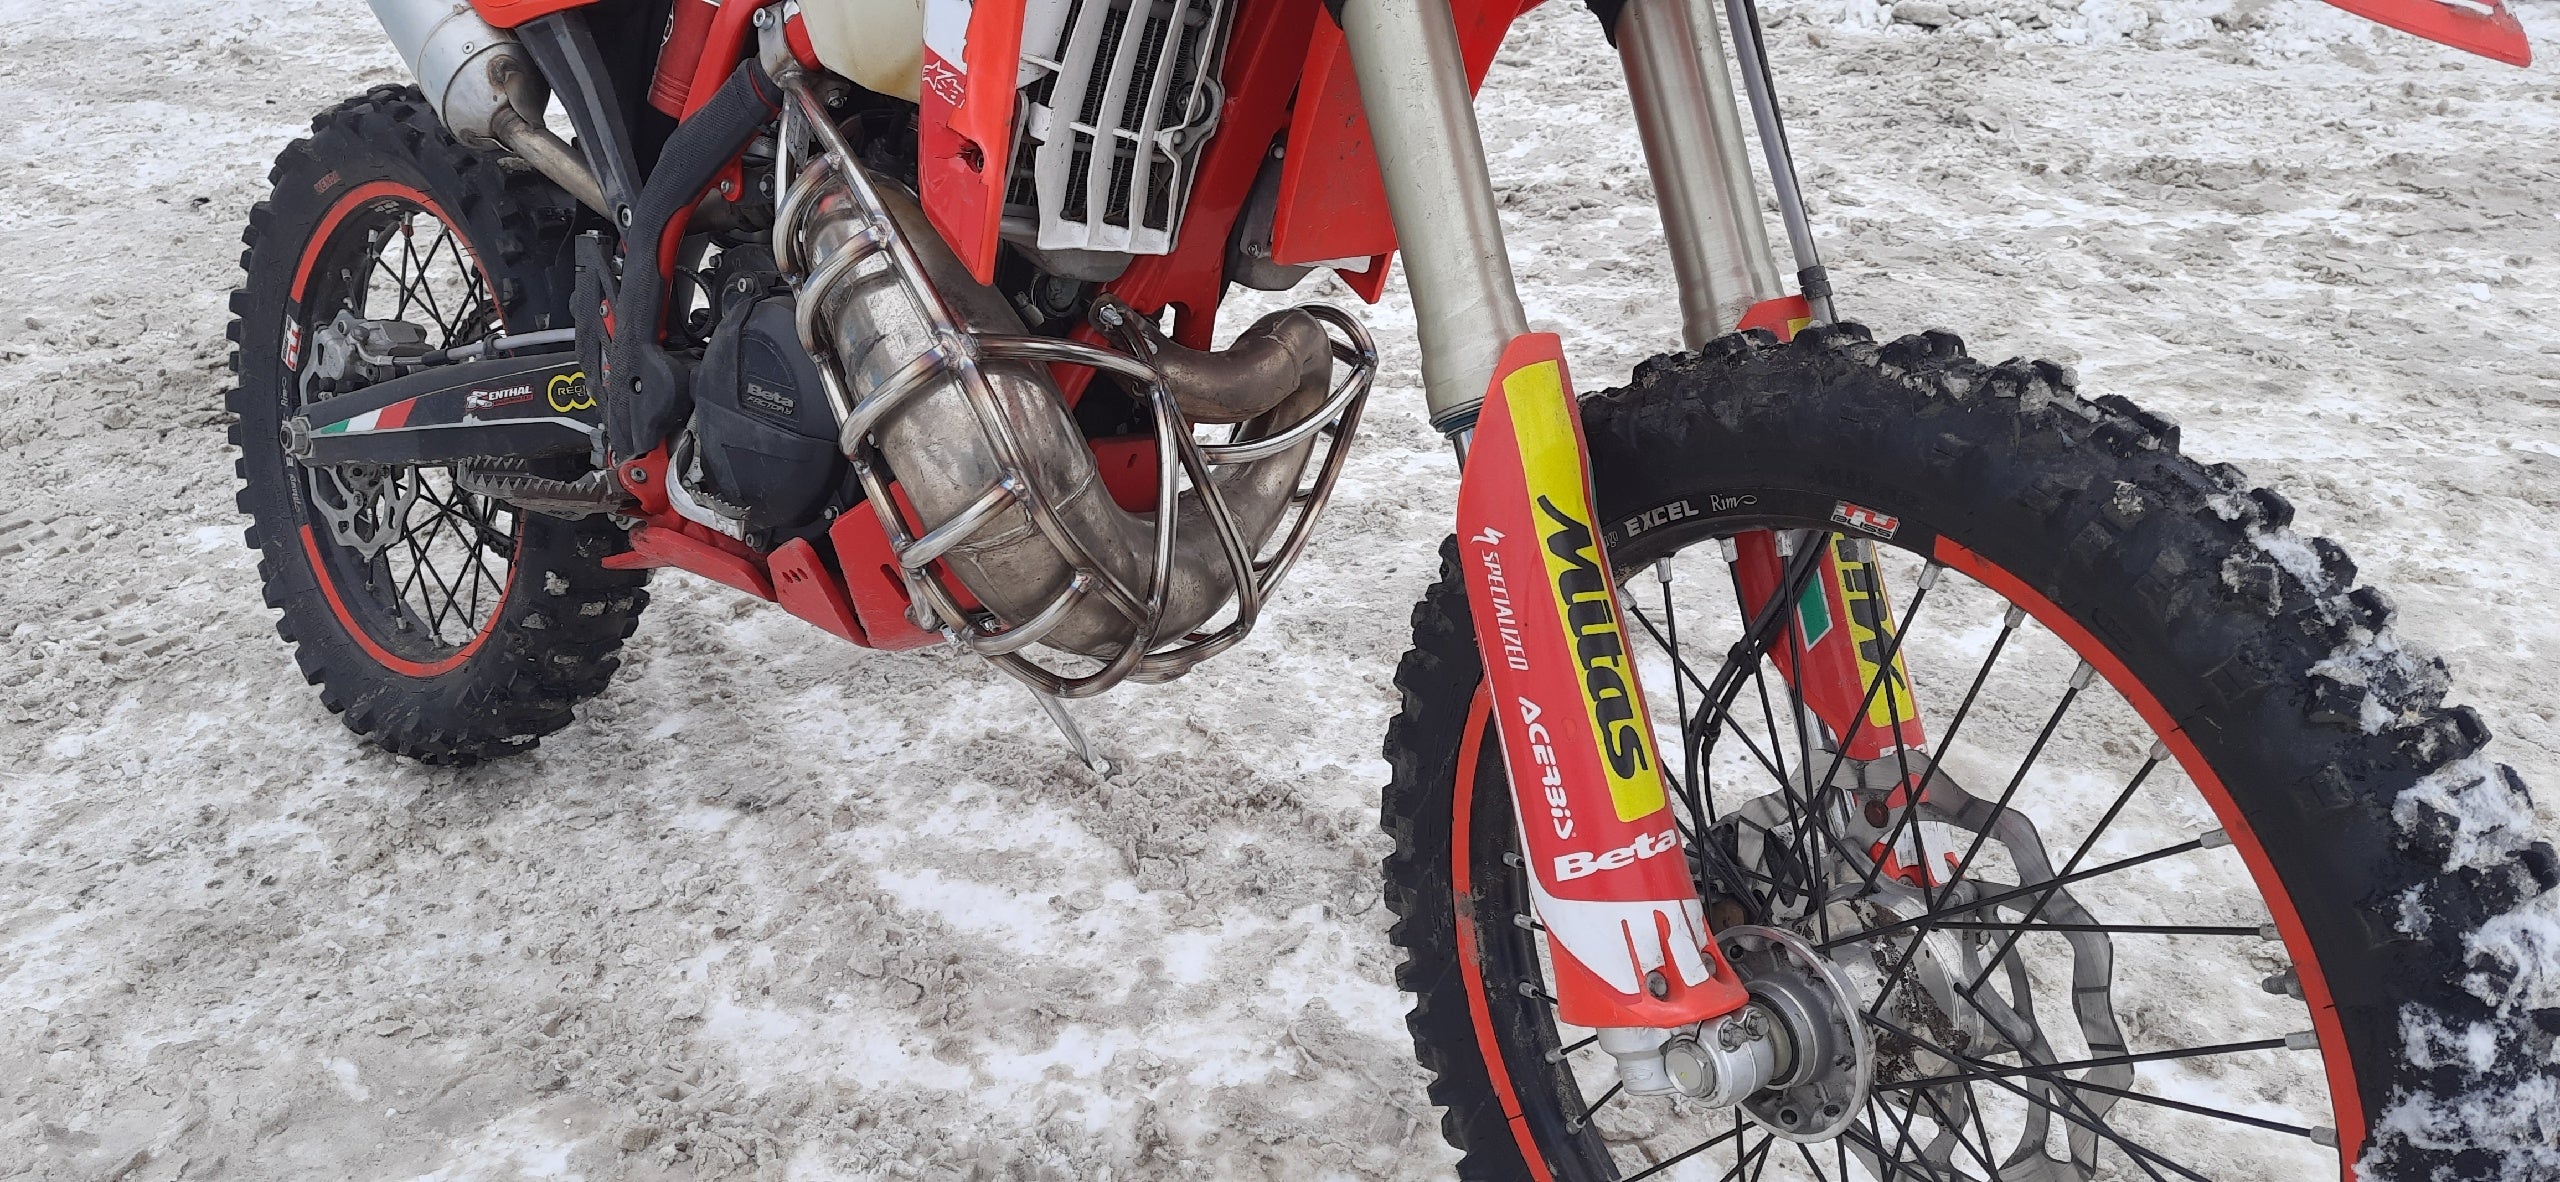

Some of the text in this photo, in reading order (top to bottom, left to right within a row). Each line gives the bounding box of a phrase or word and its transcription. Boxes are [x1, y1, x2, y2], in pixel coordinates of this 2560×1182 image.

[747, 382, 794, 408] Beta
[747, 395, 793, 415] FACTORY
[1623, 494, 1758, 538] EXCEL Rim
[1833, 515, 1892, 537] BLISS
[1481, 549, 1530, 671] SPECIALIZED
[1537, 494, 1648, 779] Mitas
[1553, 828, 1678, 882] Beta
